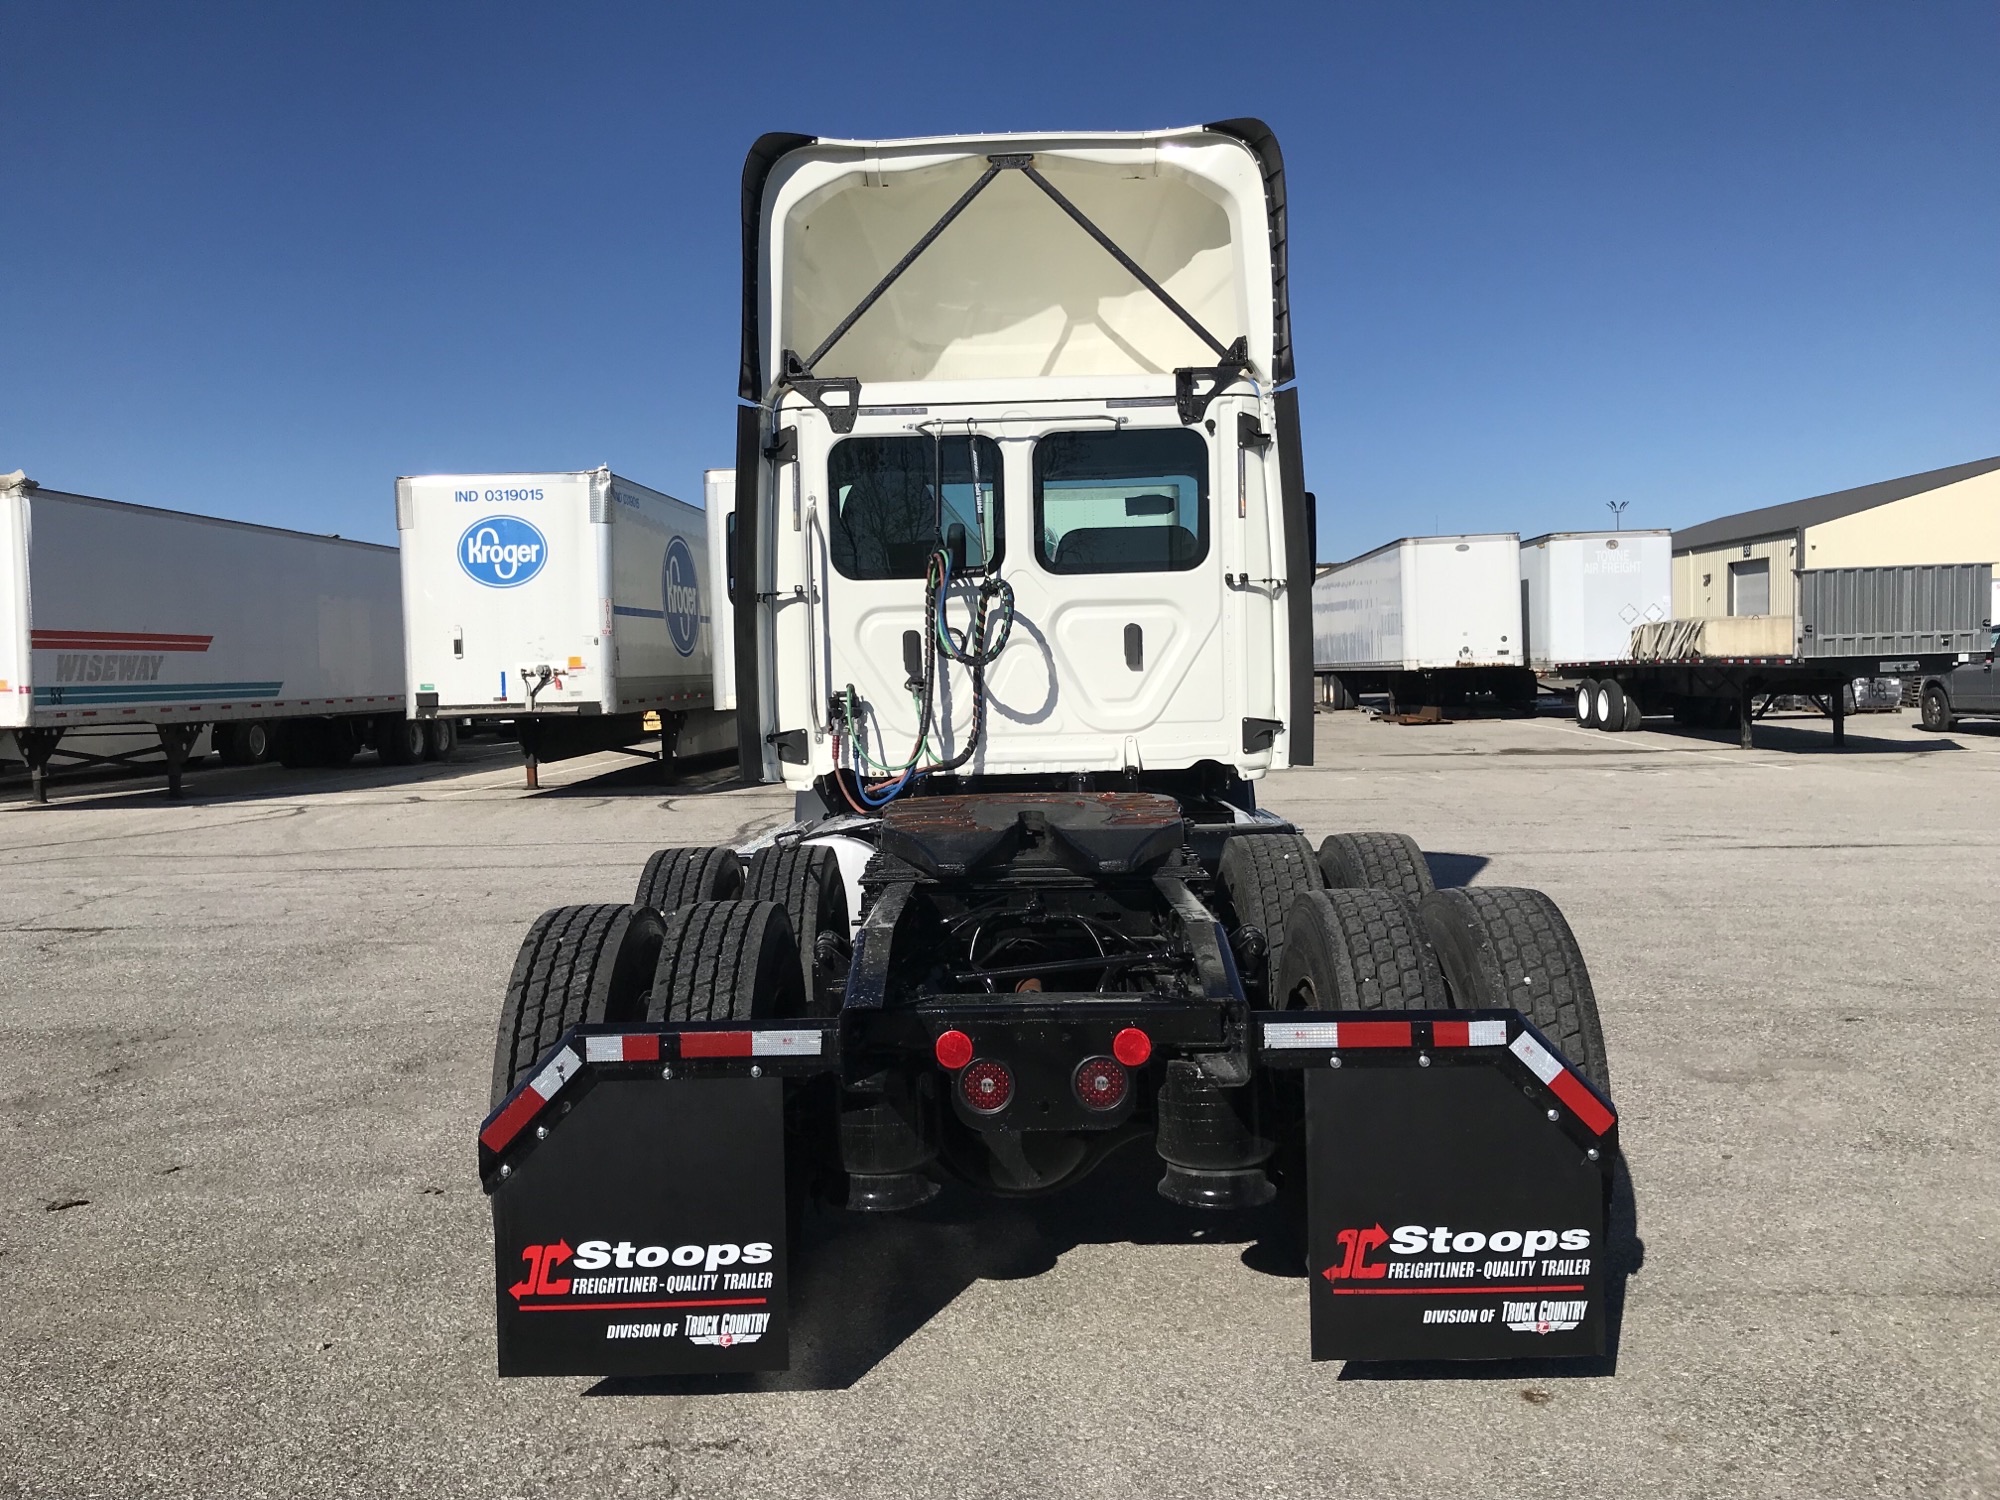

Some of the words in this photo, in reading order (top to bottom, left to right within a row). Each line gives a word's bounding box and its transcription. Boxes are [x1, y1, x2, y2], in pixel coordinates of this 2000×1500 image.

[455, 490, 479, 502] IND
[485, 489, 544, 502] 0319015
[467, 527, 540, 579] Kroger
[1595, 550, 1630, 562] TOWNE
[1584, 562, 1599, 574] AIR
[1601, 560, 1642, 574] FREIGHT
[666, 556, 697, 641] Kroger
[56, 654, 164, 682] WISEWAY
[1389, 1225, 1591, 1257] Stoops
[573, 1240, 773, 1271] Stoops
[1541, 1259, 1591, 1276] TRAILER
[723, 1272, 773, 1290] TRAILER
[1423, 1310, 1478, 1324] DIVISION
[1480, 1308, 1495, 1323] OF
[1502, 1301, 1537, 1322] TRUCK
[1538, 1300, 1588, 1322] COUNTRY
[606, 1324, 661, 1339] DIVISION
[663, 1323, 679, 1338] OF
[684, 1314, 719, 1336] TRUCK
[721, 1313, 770, 1335] COUNTRY
